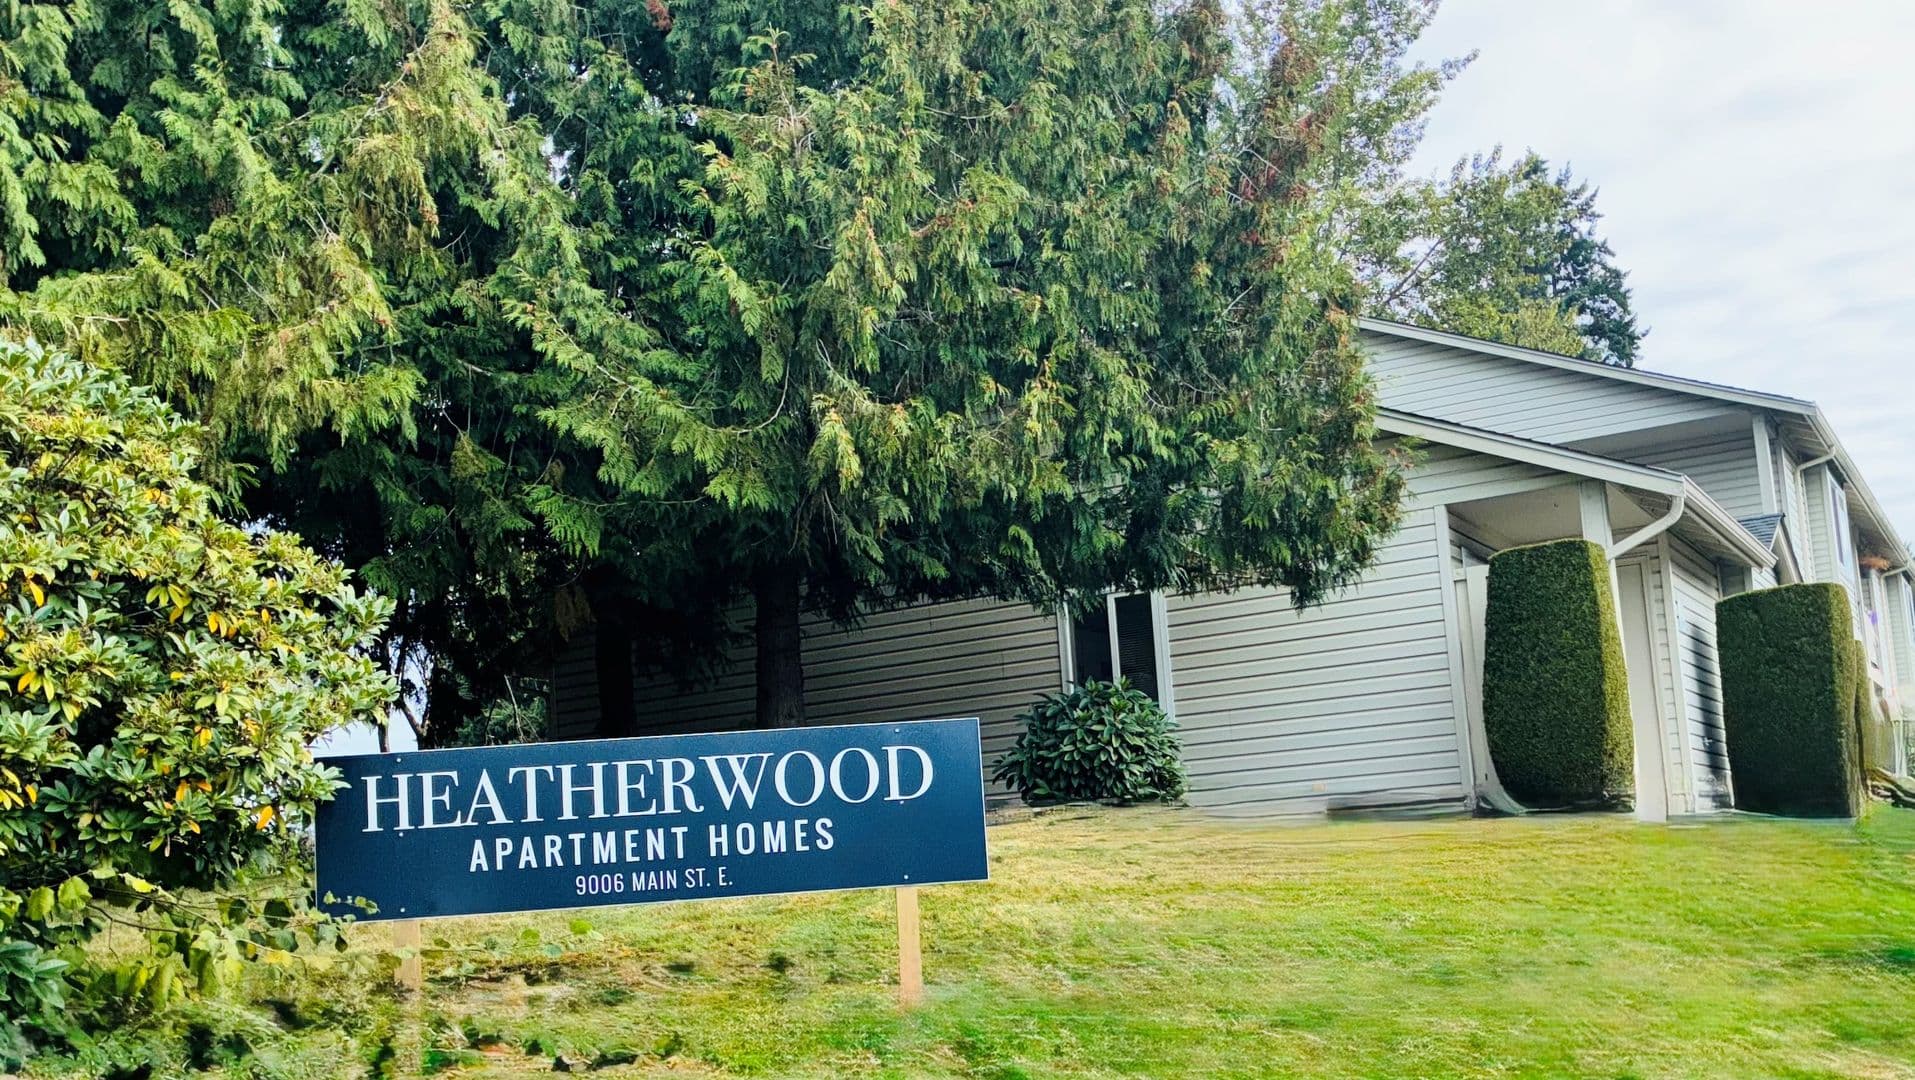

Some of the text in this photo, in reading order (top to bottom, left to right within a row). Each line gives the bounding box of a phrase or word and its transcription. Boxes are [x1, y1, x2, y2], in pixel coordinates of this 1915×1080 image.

[361, 745, 934, 833] HEATHERWOOD
[469, 817, 835, 873] APARTMENT HOMES
[575, 866, 733, 896] 9006 MAIN ST. E.
